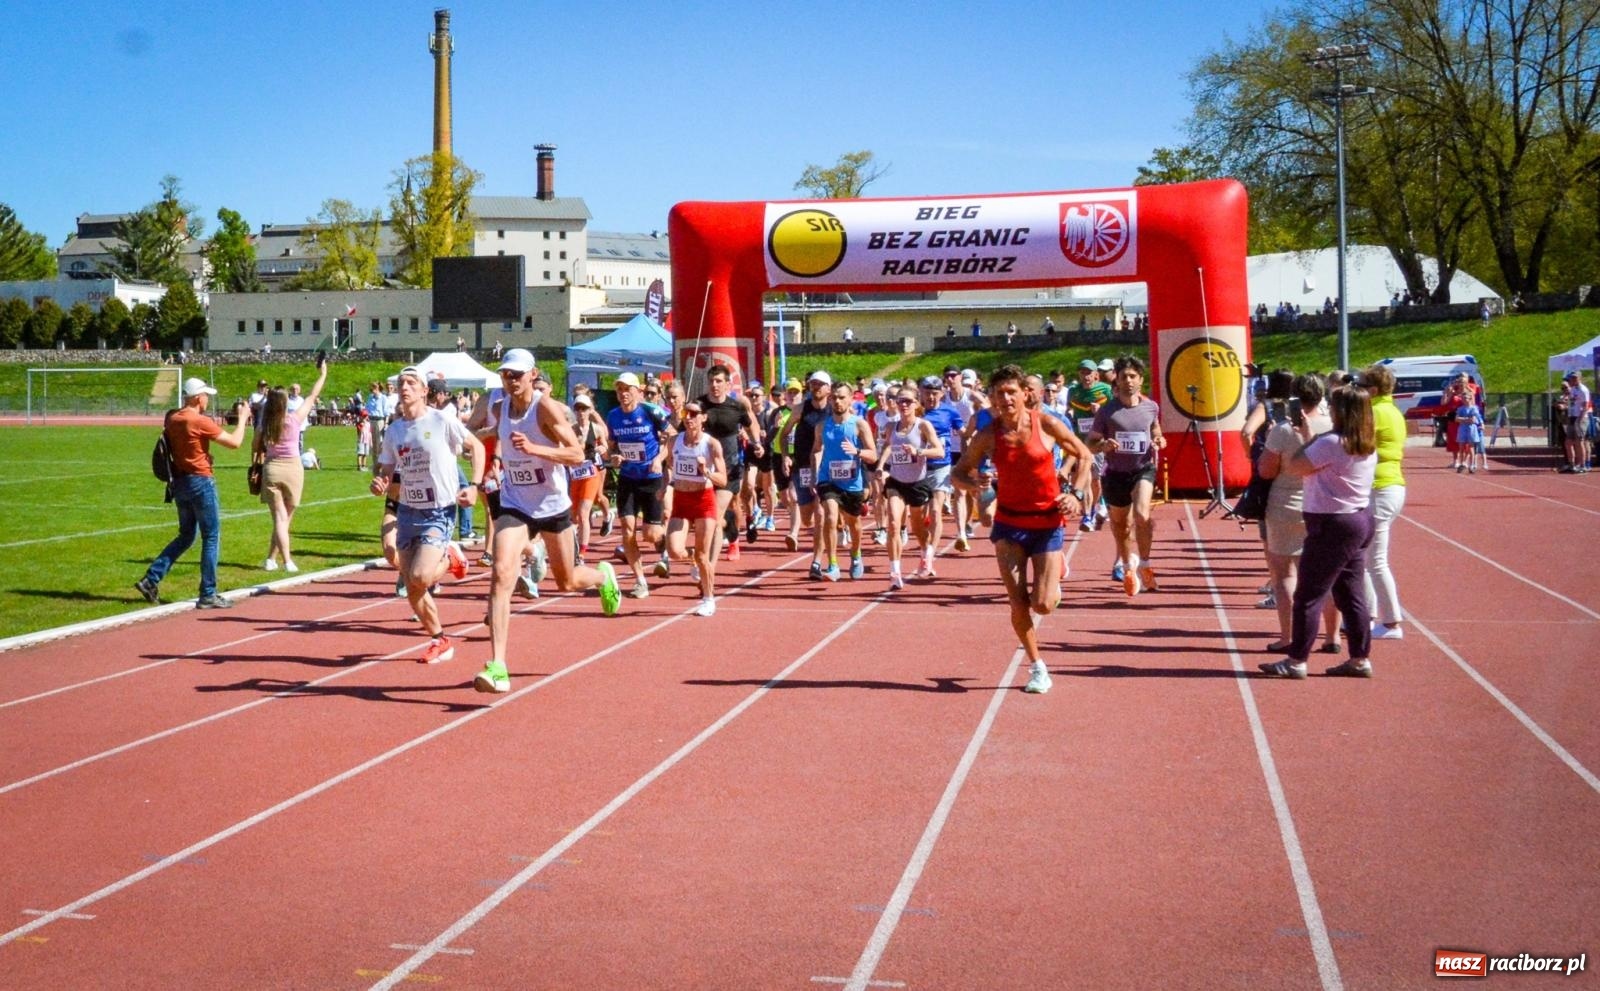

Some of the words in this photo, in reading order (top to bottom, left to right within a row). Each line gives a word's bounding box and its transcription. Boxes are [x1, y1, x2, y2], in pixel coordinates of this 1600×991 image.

[915, 205, 981, 221] BIEG
[806, 217, 846, 232] SIR
[867, 231, 923, 250] BEZ
[926, 227, 1031, 248] GRANIC
[881, 253, 1017, 275] RACIBÓRZ
[1202, 351, 1241, 368] SIR
[1122, 441, 1135, 450] 112
[679, 463, 694, 473] 135
[513, 471, 532, 482] 193
[408, 489, 424, 500] 136
